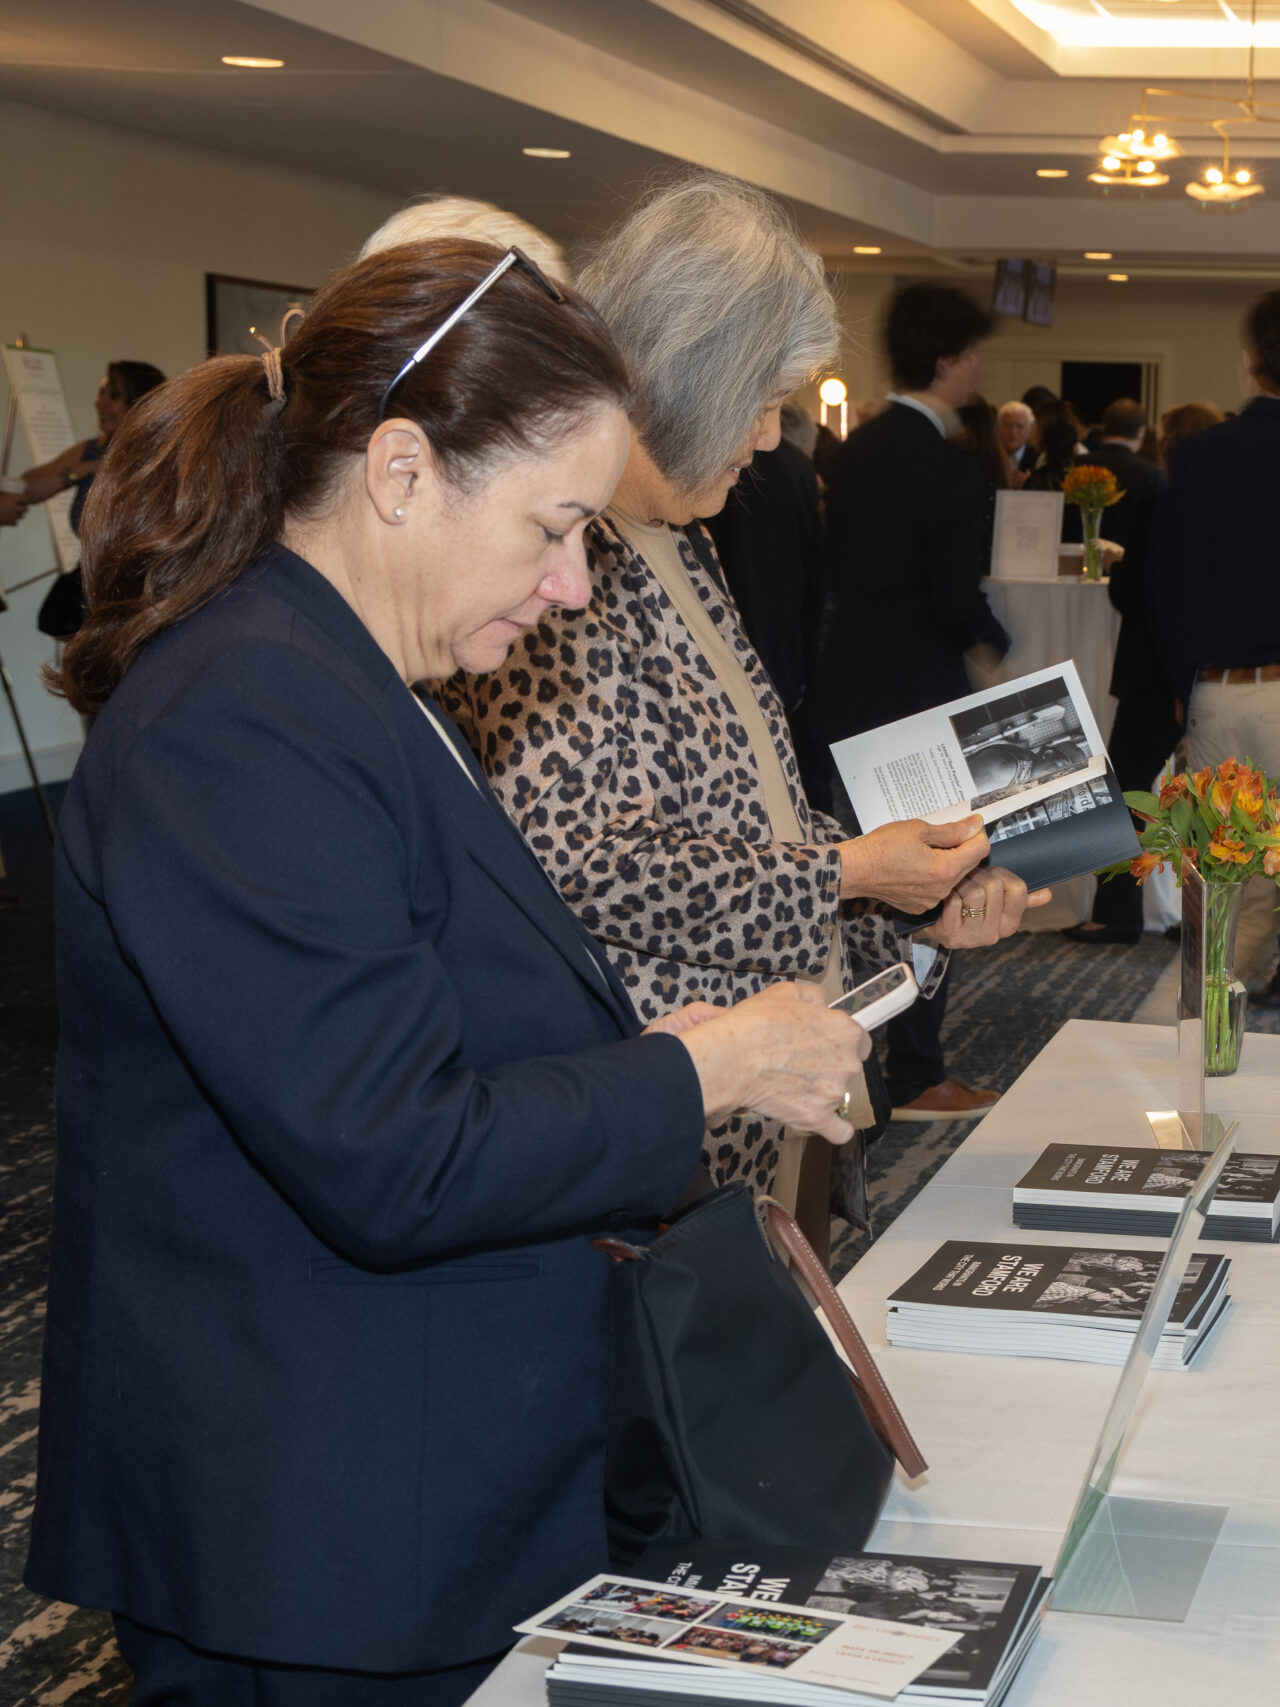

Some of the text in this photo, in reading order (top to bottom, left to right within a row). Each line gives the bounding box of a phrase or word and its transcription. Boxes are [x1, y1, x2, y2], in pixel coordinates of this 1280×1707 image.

[1085, 1153, 1120, 1184] STAMFORD
[1110, 1160, 1140, 1182] WE ARE
[972, 1255, 1022, 1296] STAMFORD
[1002, 1263, 1045, 1293] WE ARE
[671, 1562, 693, 1576] THE
[749, 1578, 791, 1602] WE
